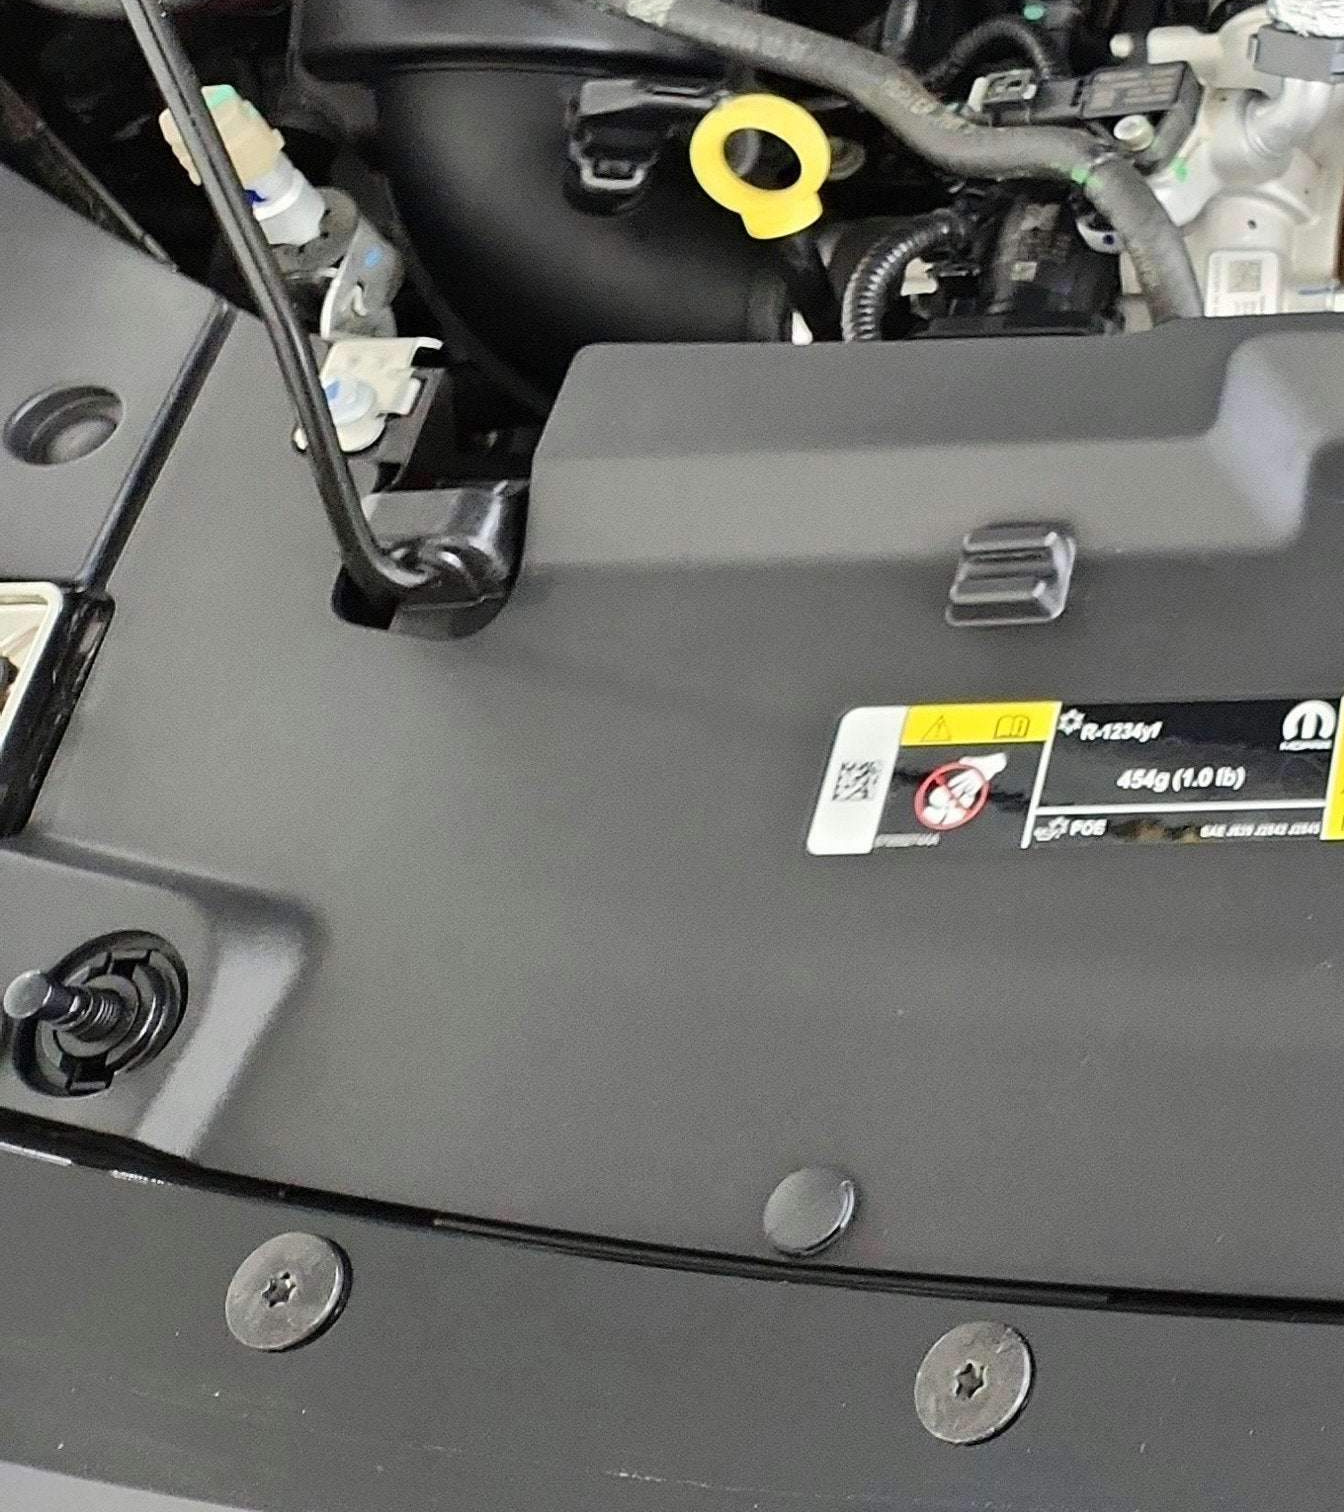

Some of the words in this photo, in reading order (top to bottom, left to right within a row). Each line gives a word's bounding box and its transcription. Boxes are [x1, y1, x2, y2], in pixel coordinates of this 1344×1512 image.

[1117, 769, 1171, 793] 454g
[1172, 767, 1214, 792] (1.0
[1216, 766, 1246, 791] lb)
[1069, 819, 1107, 836] POE
